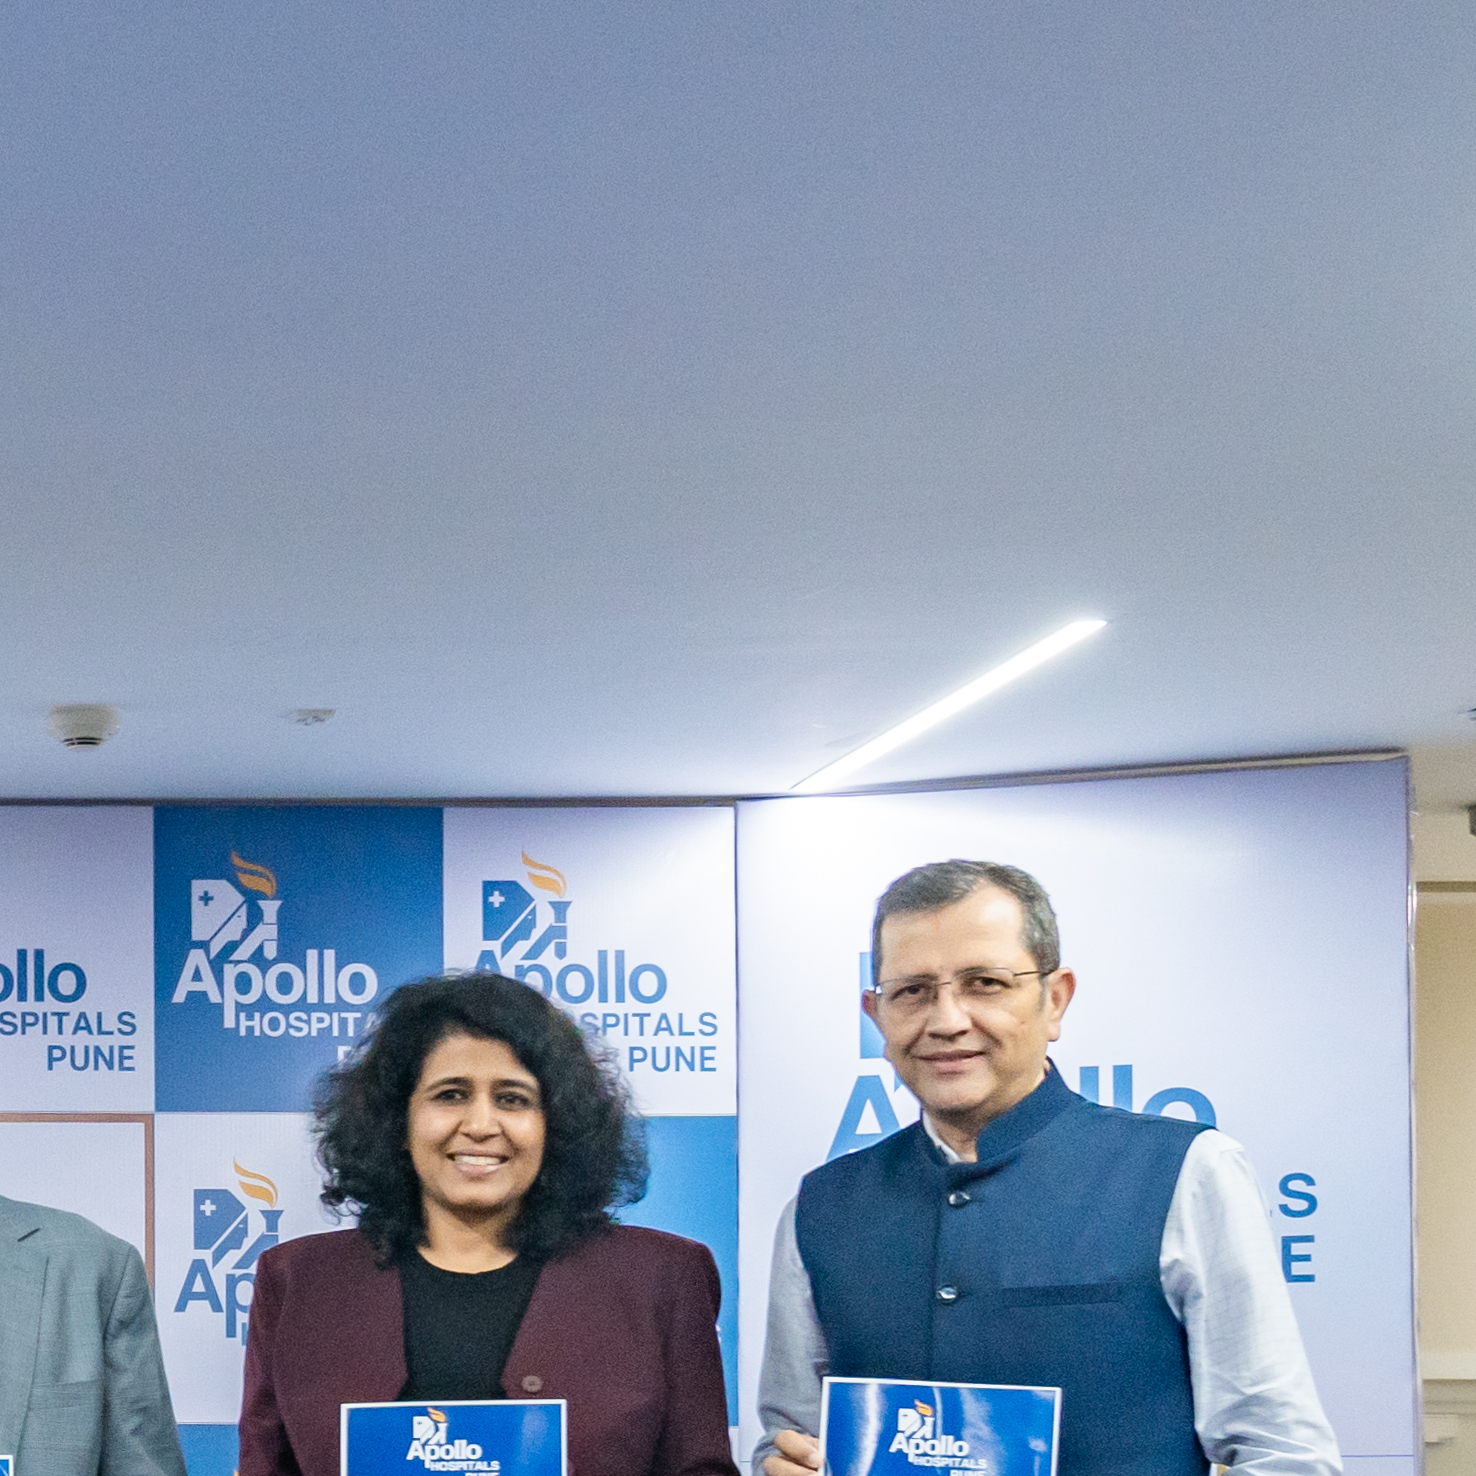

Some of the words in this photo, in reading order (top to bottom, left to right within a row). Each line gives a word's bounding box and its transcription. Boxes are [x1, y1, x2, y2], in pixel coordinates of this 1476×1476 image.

[171, 948, 378, 1029] Apollo
[239, 1011, 374, 1038] HOSPIT
[47, 1045, 136, 1072] PUNE
[628, 1046, 717, 1072] PUNE
[405, 1439, 483, 1469] Apollo
[888, 1432, 969, 1463] Apollo
[429, 1460, 501, 1471] HOSPITALS
[913, 1456, 988, 1469] HOSPITALS
